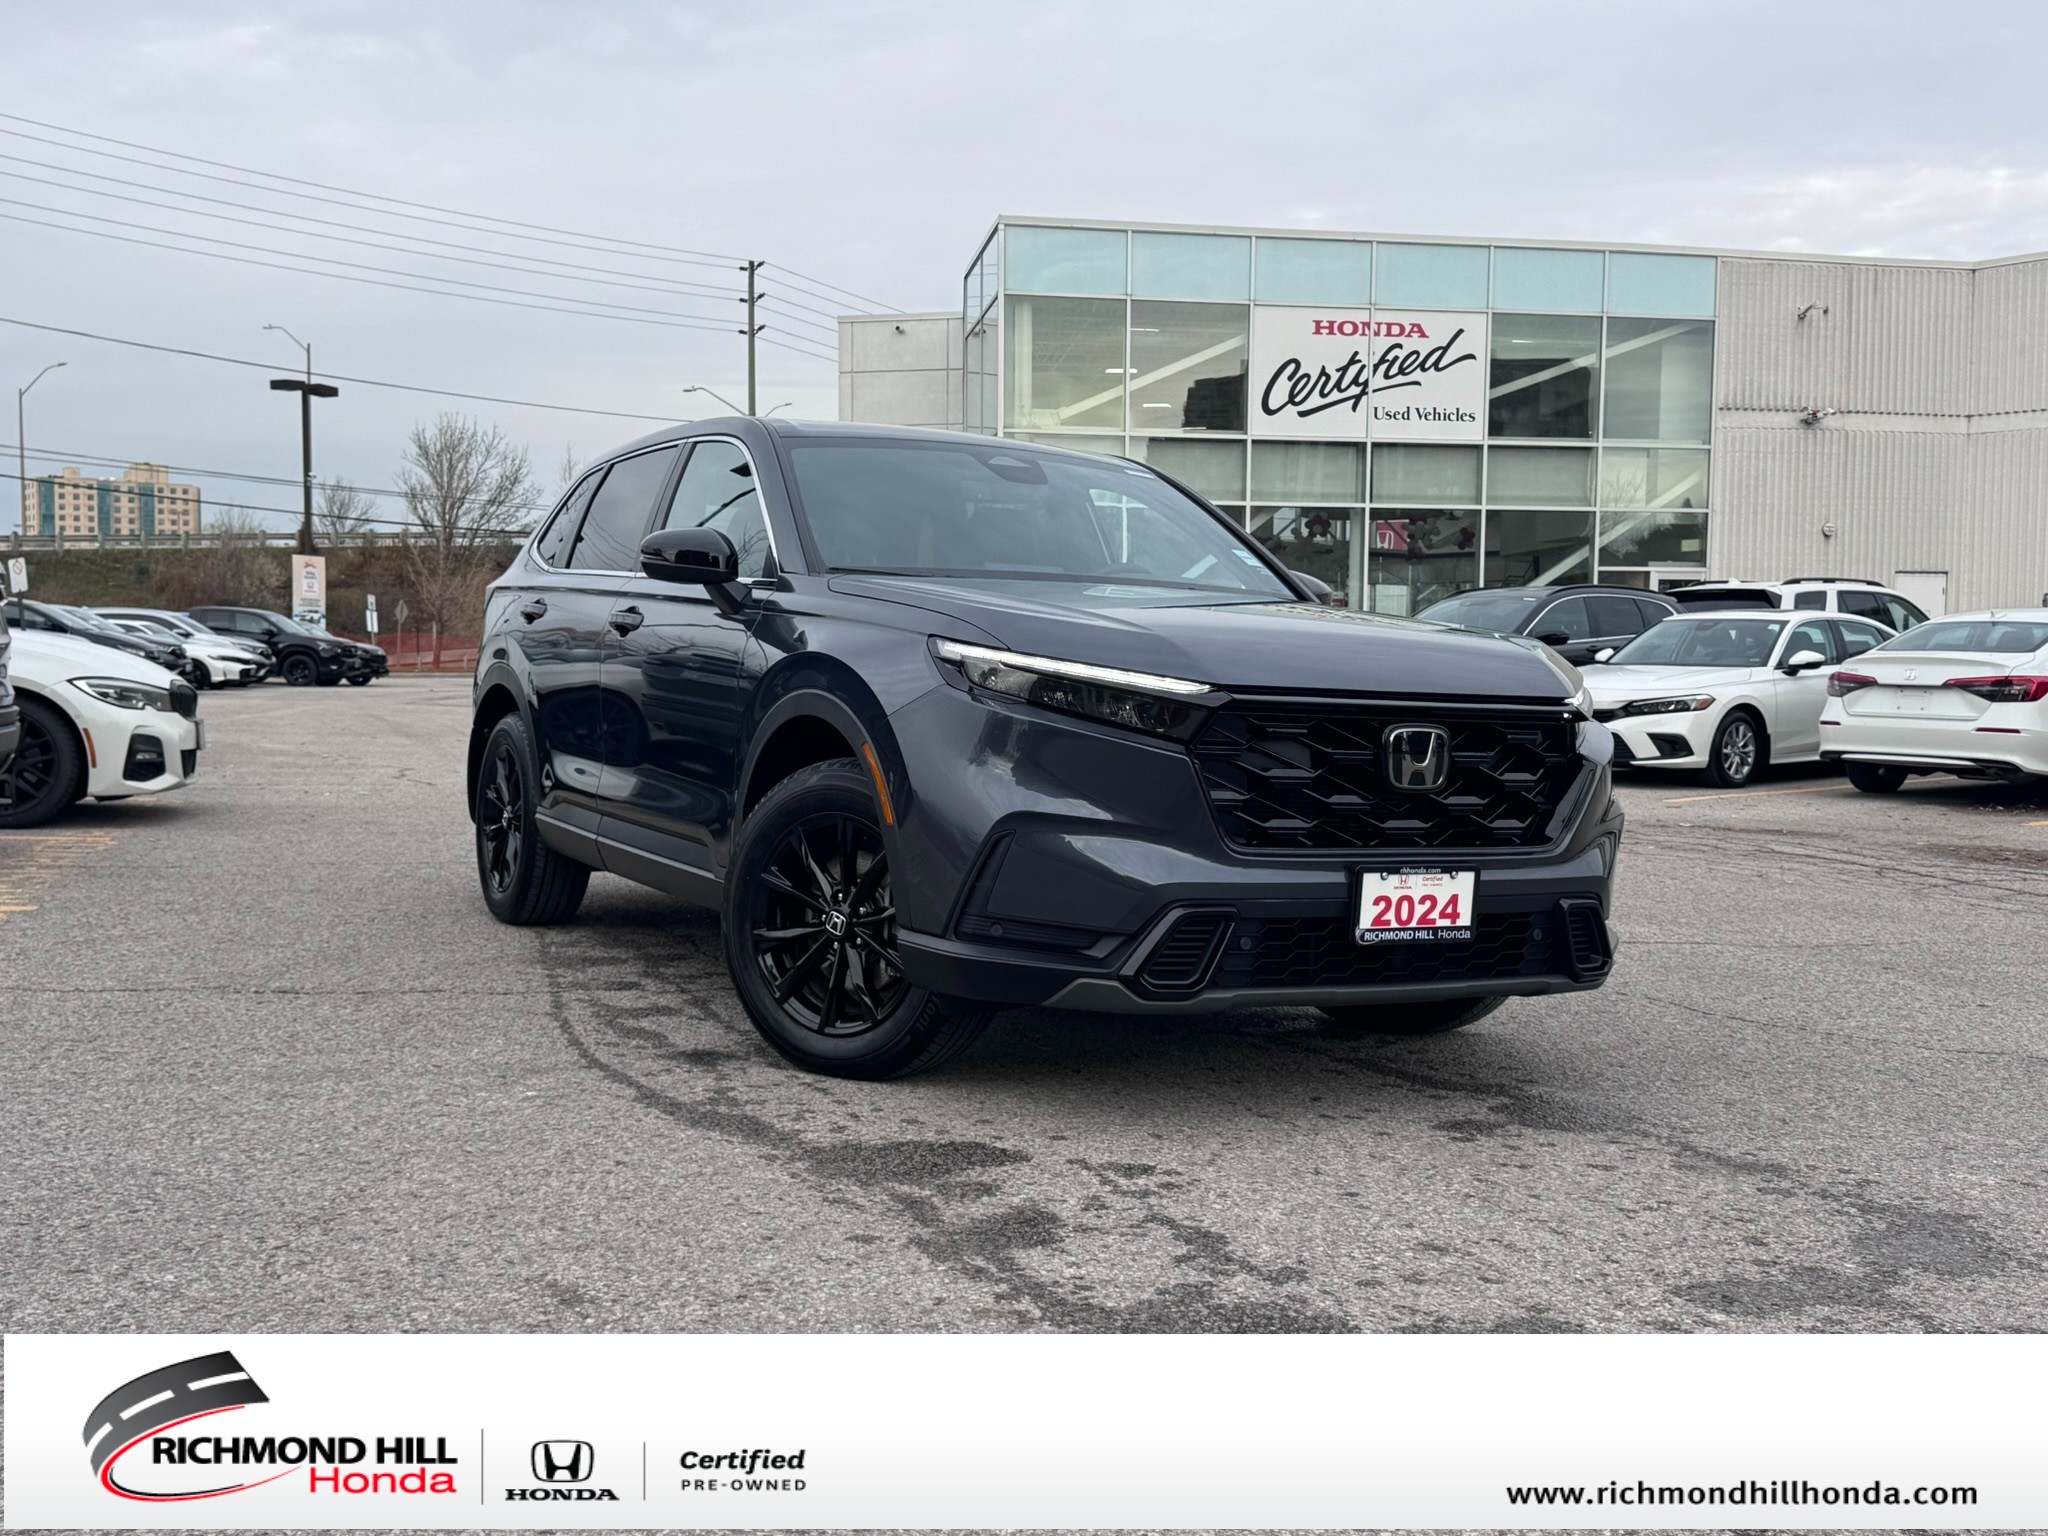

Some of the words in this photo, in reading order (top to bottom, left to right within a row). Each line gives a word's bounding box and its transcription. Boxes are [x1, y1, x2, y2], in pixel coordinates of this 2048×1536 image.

[1311, 319, 1430, 339] HONDA
[1261, 328, 1477, 416] Certified
[1373, 406, 1411, 421] Used
[1414, 407, 1476, 422] Vehicles
[1370, 894, 1460, 927] 2024
[1364, 930, 1414, 941] RICHMOND
[1415, 930, 1434, 940] HILL
[1437, 929, 1471, 939] Honda
